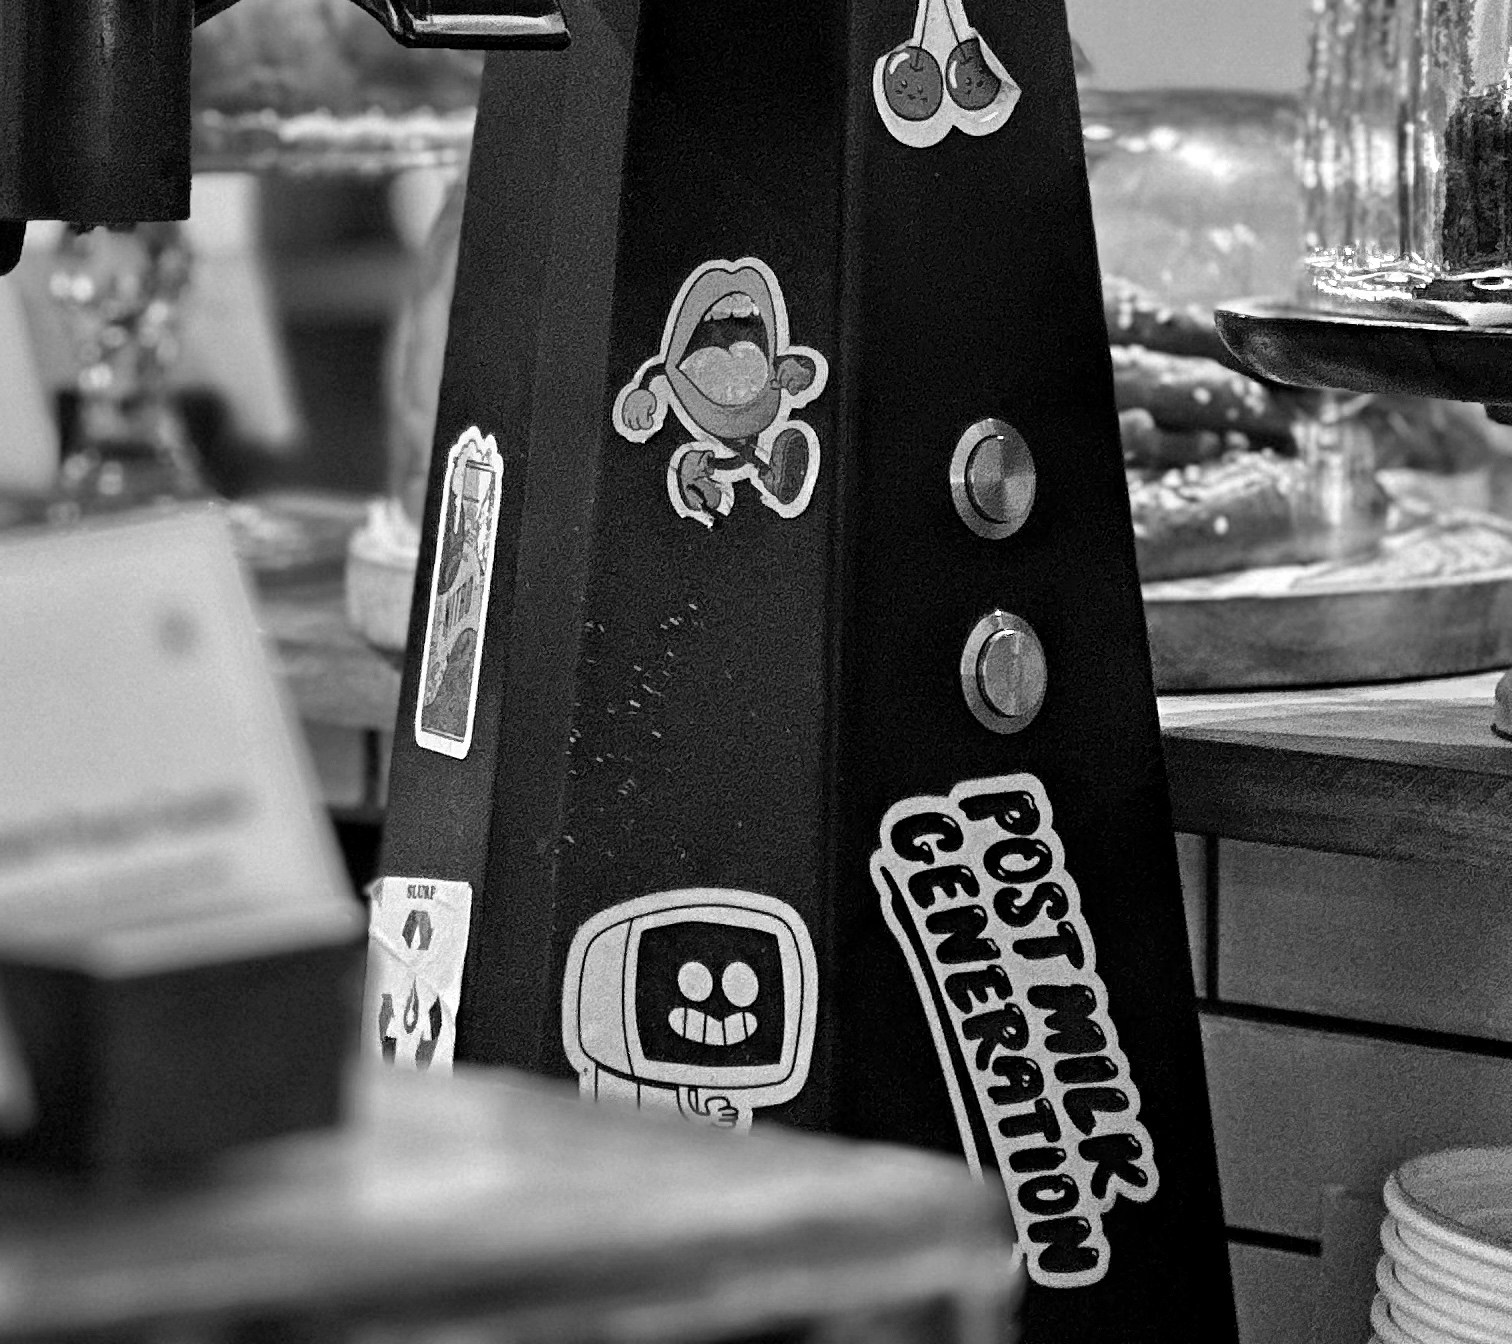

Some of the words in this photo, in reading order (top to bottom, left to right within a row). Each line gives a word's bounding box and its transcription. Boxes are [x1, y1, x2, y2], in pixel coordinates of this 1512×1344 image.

[889, 811, 1101, 1275] GENERATION
[957, 789, 1086, 971] POST
[1025, 982, 1150, 1200] MILK
